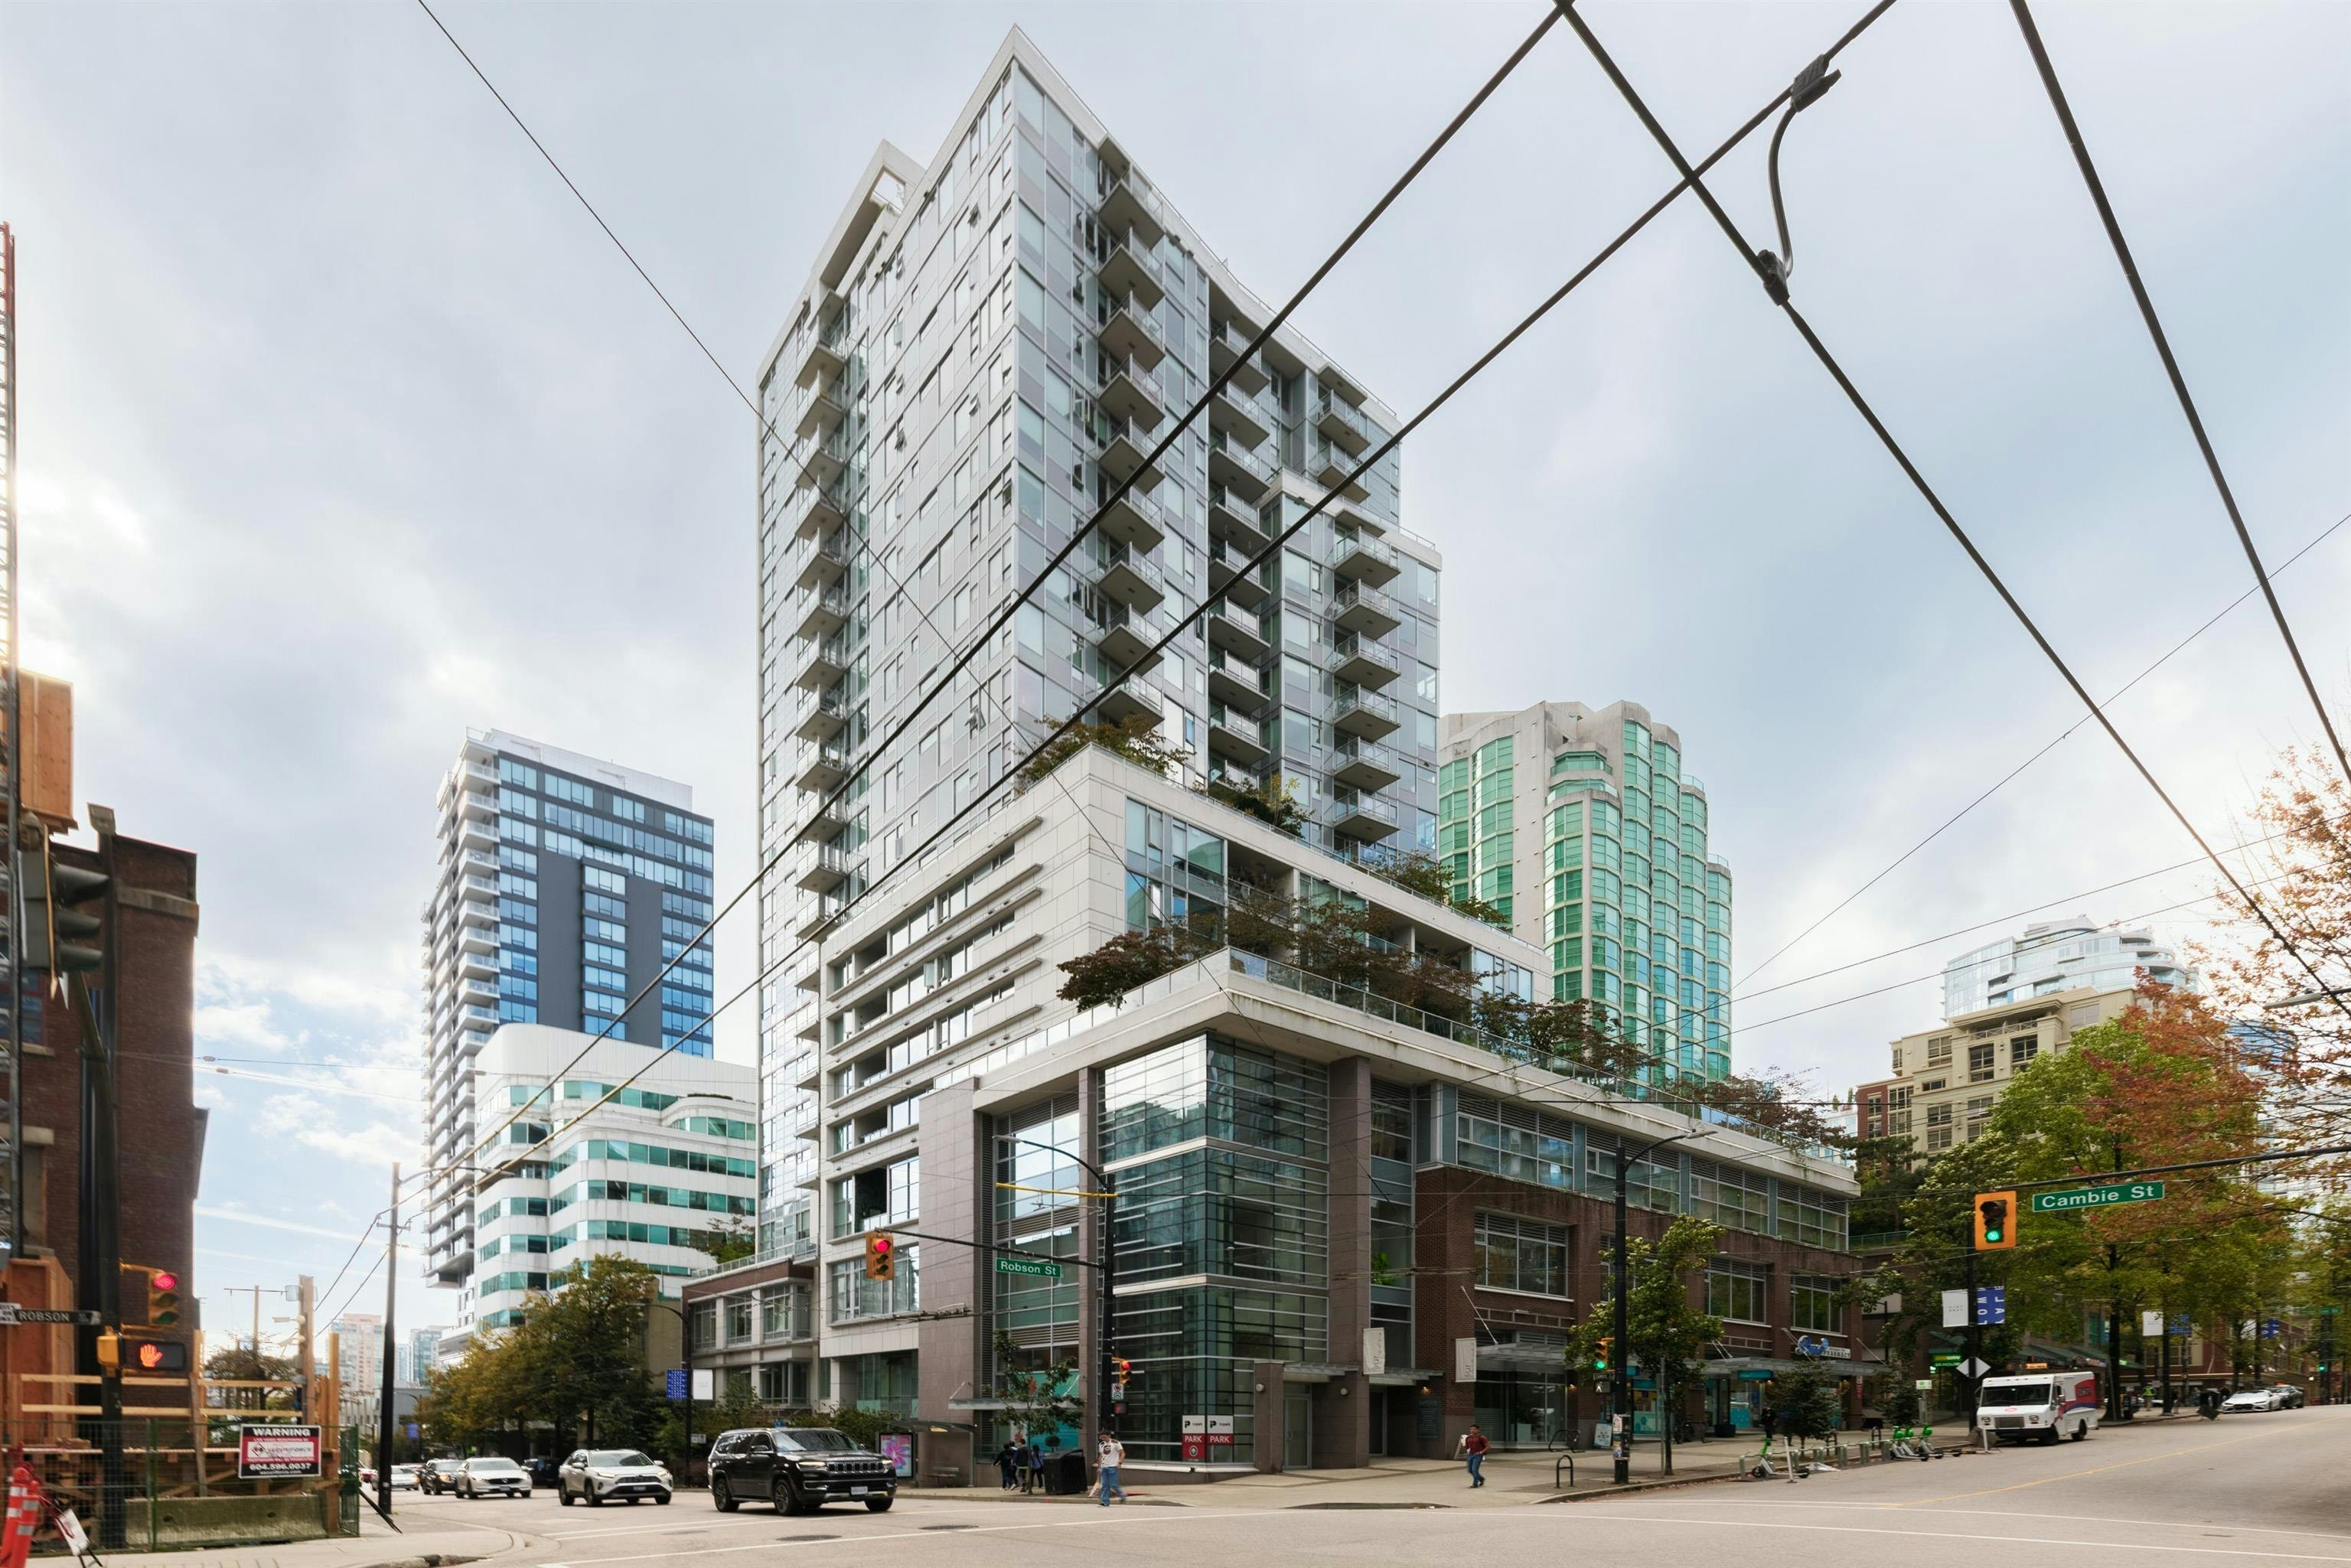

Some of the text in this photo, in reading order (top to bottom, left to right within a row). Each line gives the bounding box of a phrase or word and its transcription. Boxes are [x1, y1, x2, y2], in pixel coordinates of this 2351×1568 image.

[2042, 1185, 2154, 1208] Cambie St
[1000, 1261, 1056, 1275] Robson St
[18, 1311, 70, 1322] ROBSON
[253, 1428, 311, 1436] WARNING
